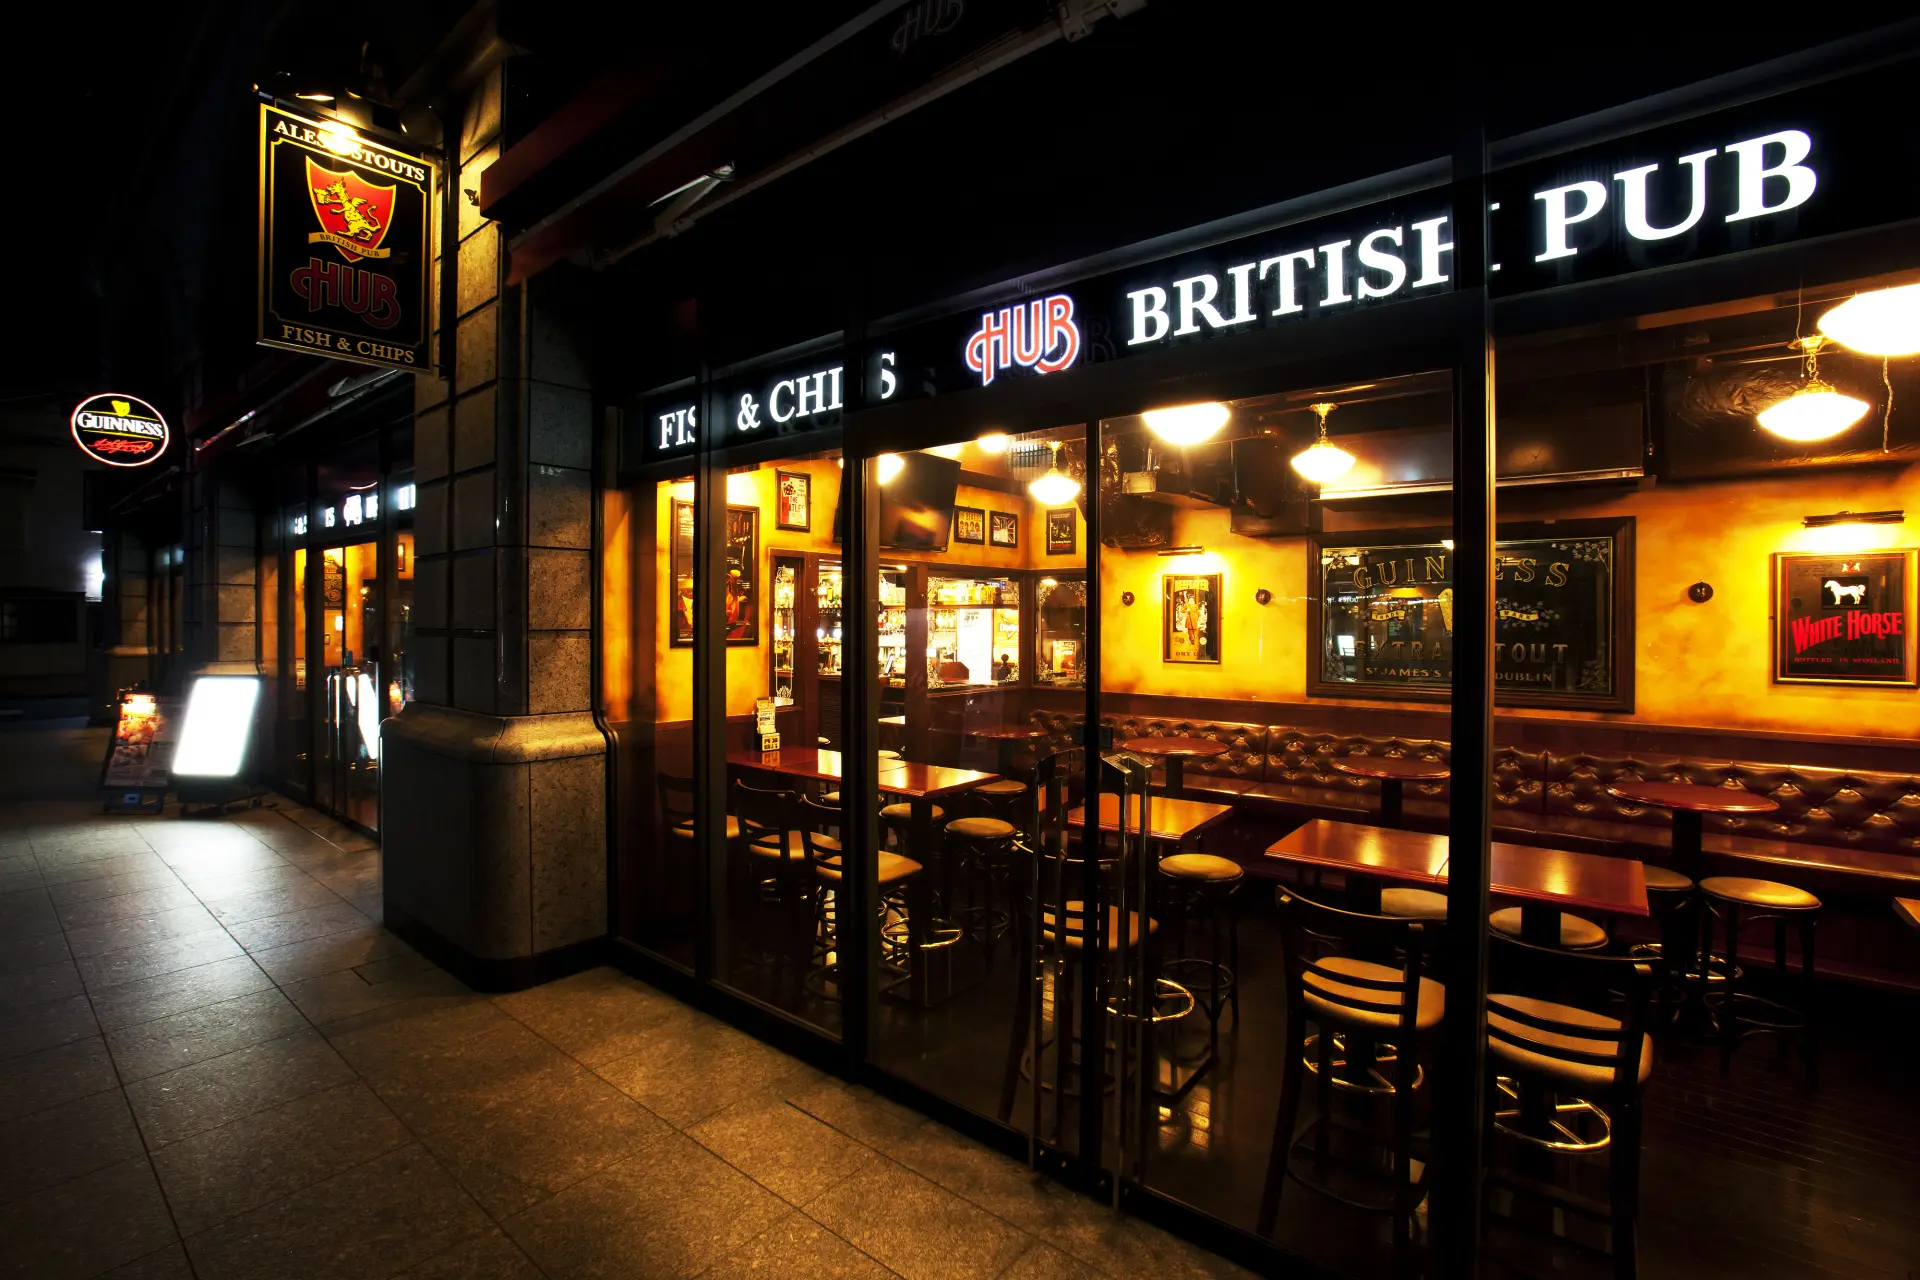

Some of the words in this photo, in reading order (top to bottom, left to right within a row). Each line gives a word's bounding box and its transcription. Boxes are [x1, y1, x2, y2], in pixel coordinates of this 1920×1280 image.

[350, 146, 425, 181] STOUTS
[1535, 129, 1818, 263] PUB
[319, 234, 358, 254] BRITISH
[360, 247, 381, 257] PUB
[290, 257, 402, 330] HUB
[281, 324, 332, 349] FISH
[336, 337, 353, 352] &
[356, 340, 415, 365] CHIPS
[964, 292, 1081, 387] HUB
[658, 405, 696, 450] FIS
[737, 393, 761, 431] &
[769, 352, 897, 423] CHIS
[76, 412, 164, 438] GUINNESS
[1353, 555, 1570, 589] GUINESS
[1354, 640, 1446, 661] EXTRA
[1495, 642, 1568, 664] TOUT
[1791, 615, 1843, 655] WHITE
[1846, 609, 1903, 640] HORSE
